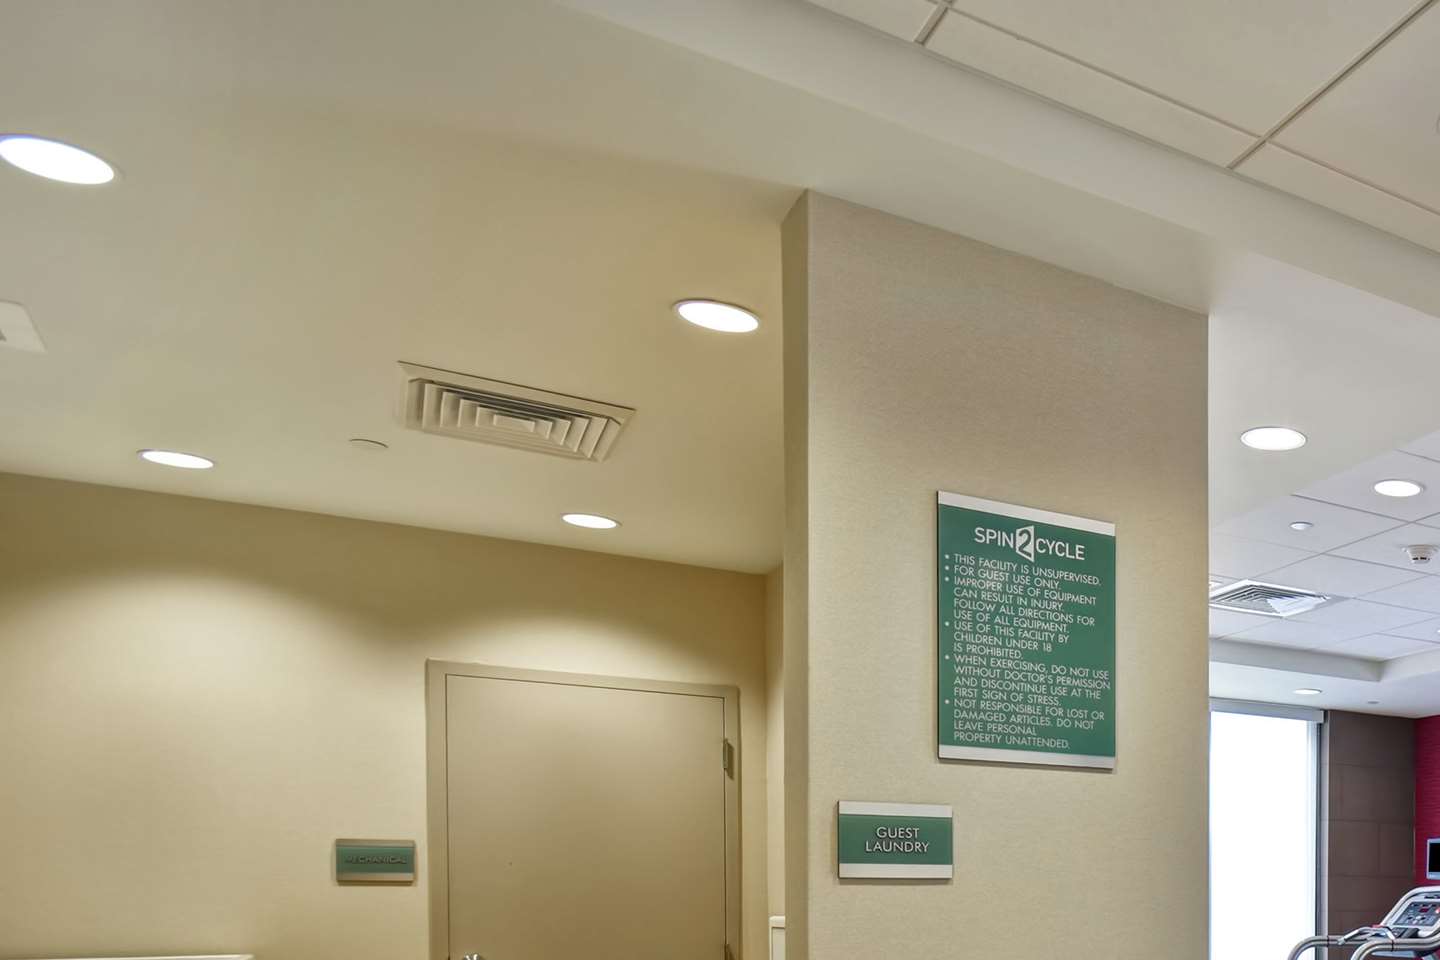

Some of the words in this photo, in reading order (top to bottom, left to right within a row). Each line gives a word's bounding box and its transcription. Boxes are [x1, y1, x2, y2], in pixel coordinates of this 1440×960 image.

[954, 554, 974, 565] THIS
[979, 558, 1017, 572] FACILITY
[1020, 563, 1029, 574] IS
[954, 565, 974, 576] FOR
[978, 569, 1009, 581] GUEST
[1013, 575, 1030, 585] USE
[954, 576, 1002, 591] IMPROPER
[1006, 585, 1024, 595] USE
[1027, 587, 1041, 597] OF
[1045, 591, 1096, 605] EQUIPMENT
[954, 588, 977, 597] CAN
[981, 592, 1013, 604] RESULT
[1017, 595, 1027, 605] IN
[954, 599, 996, 612] FOLLOW
[1000, 606, 1015, 615] ALL
[1019, 608, 1073, 623] DIRECTIONS
[1077, 616, 1094, 626] FOR
[954, 610, 972, 620] USE
[976, 613, 991, 622] OF
[994, 616, 1010, 625] ALL
[954, 621, 972, 631] USE
[977, 624, 991, 633] OF
[995, 626, 1014, 636] THIS
[1018, 629, 1055, 642] FACILITY
[1059, 635, 1069, 644] BY
[954, 632, 1002, 645] CHILDREN
[1006, 637, 1038, 650] UNDER
[1043, 643, 1052, 652] 18
[954, 643, 962, 652] IS
[954, 655, 986, 666] WHEN
[1052, 666, 1066, 675] DO
[1070, 667, 1089, 677] NOT
[1093, 670, 1109, 679] USE
[954, 666, 1001, 678] WITHOUT
[1004, 671, 1053, 684] DOCTOR'S
[1057, 676, 1110, 689] PERMISSION
[954, 678, 977, 687] AND
[981, 679, 1047, 694] DISCONTINUE
[1051, 686, 1067, 696] USE
[1071, 689, 1082, 697] AT
[1085, 690, 1101, 699] THE
[954, 689, 978, 698] FIRST
[982, 691, 1006, 700] SIGN
[1010, 693, 1024, 702] OF
[954, 699, 977, 708] NOT
[980, 700, 1041, 715] RESPONSIBLE
[1045, 707, 1063, 716] FOR
[1067, 709, 1087, 718] LOST
[1091, 711, 1104, 720] OR
[954, 710, 1006, 722] DAMAGED
[1057, 718, 1071, 727] DO
[1075, 720, 1094, 730] NOT
[954, 721, 983, 731] LEAVE
[987, 724, 1036, 735] PERSONAL
[954, 732, 1001, 743] PROPERTY
[876, 827, 920, 839] GUEST
[865, 841, 930, 852] LAUNDRY
